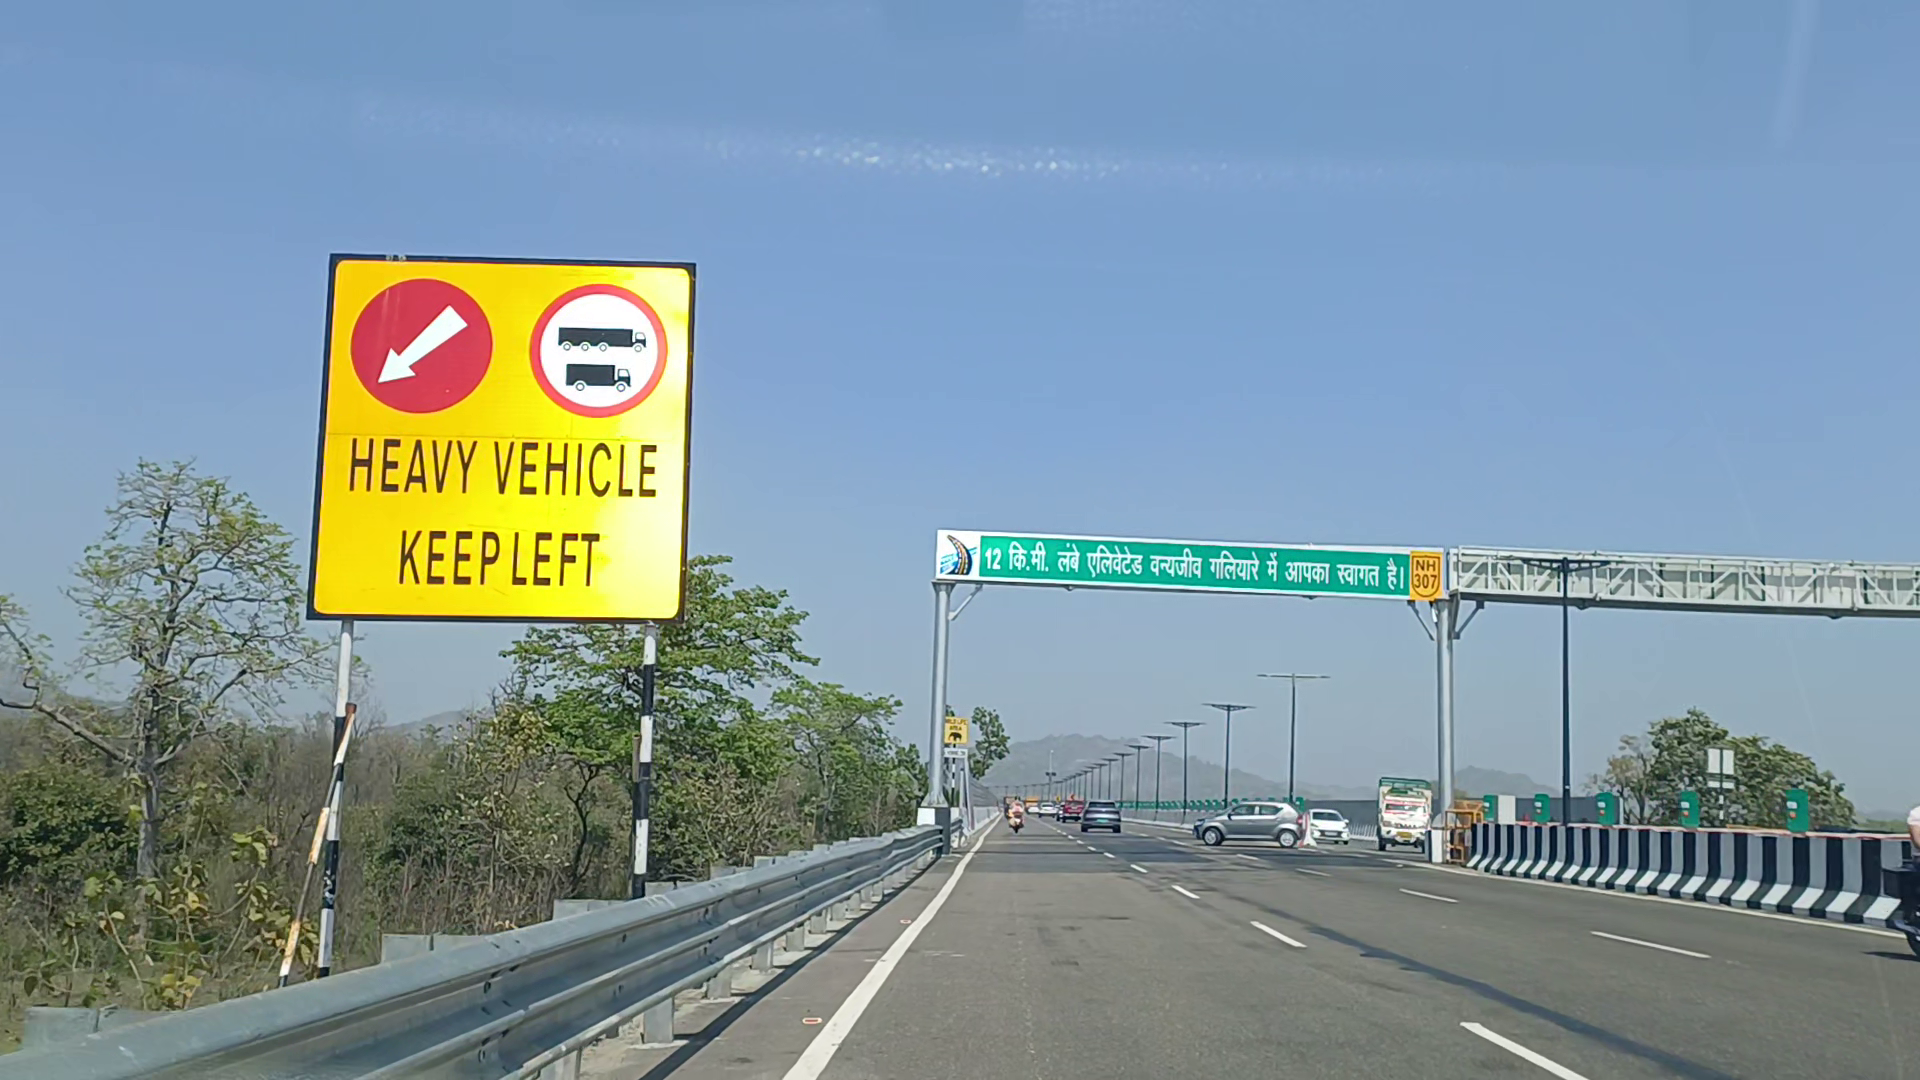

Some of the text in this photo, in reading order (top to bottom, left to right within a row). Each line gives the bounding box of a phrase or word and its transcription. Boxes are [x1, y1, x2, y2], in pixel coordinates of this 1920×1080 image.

[349, 438, 657, 498] HEAVY VEHICLE
[398, 530, 600, 587] KEEP LEFT
[985, 547, 1002, 570] 12
[1008, 541, 1049, 572] कि.मी.
[1057, 543, 1080, 573] लंबे
[1086, 545, 1143, 578] एलिवेटेड
[1149, 547, 1203, 579] वन्यजीव
[1208, 550, 1260, 581] गलियारे
[1266, 552, 1279, 582] में
[1285, 559, 1330, 585] आपका
[1336, 562, 1380, 588] स्वागत
[1414, 574, 1438, 589] 307
[1415, 559, 1436, 571] NH
